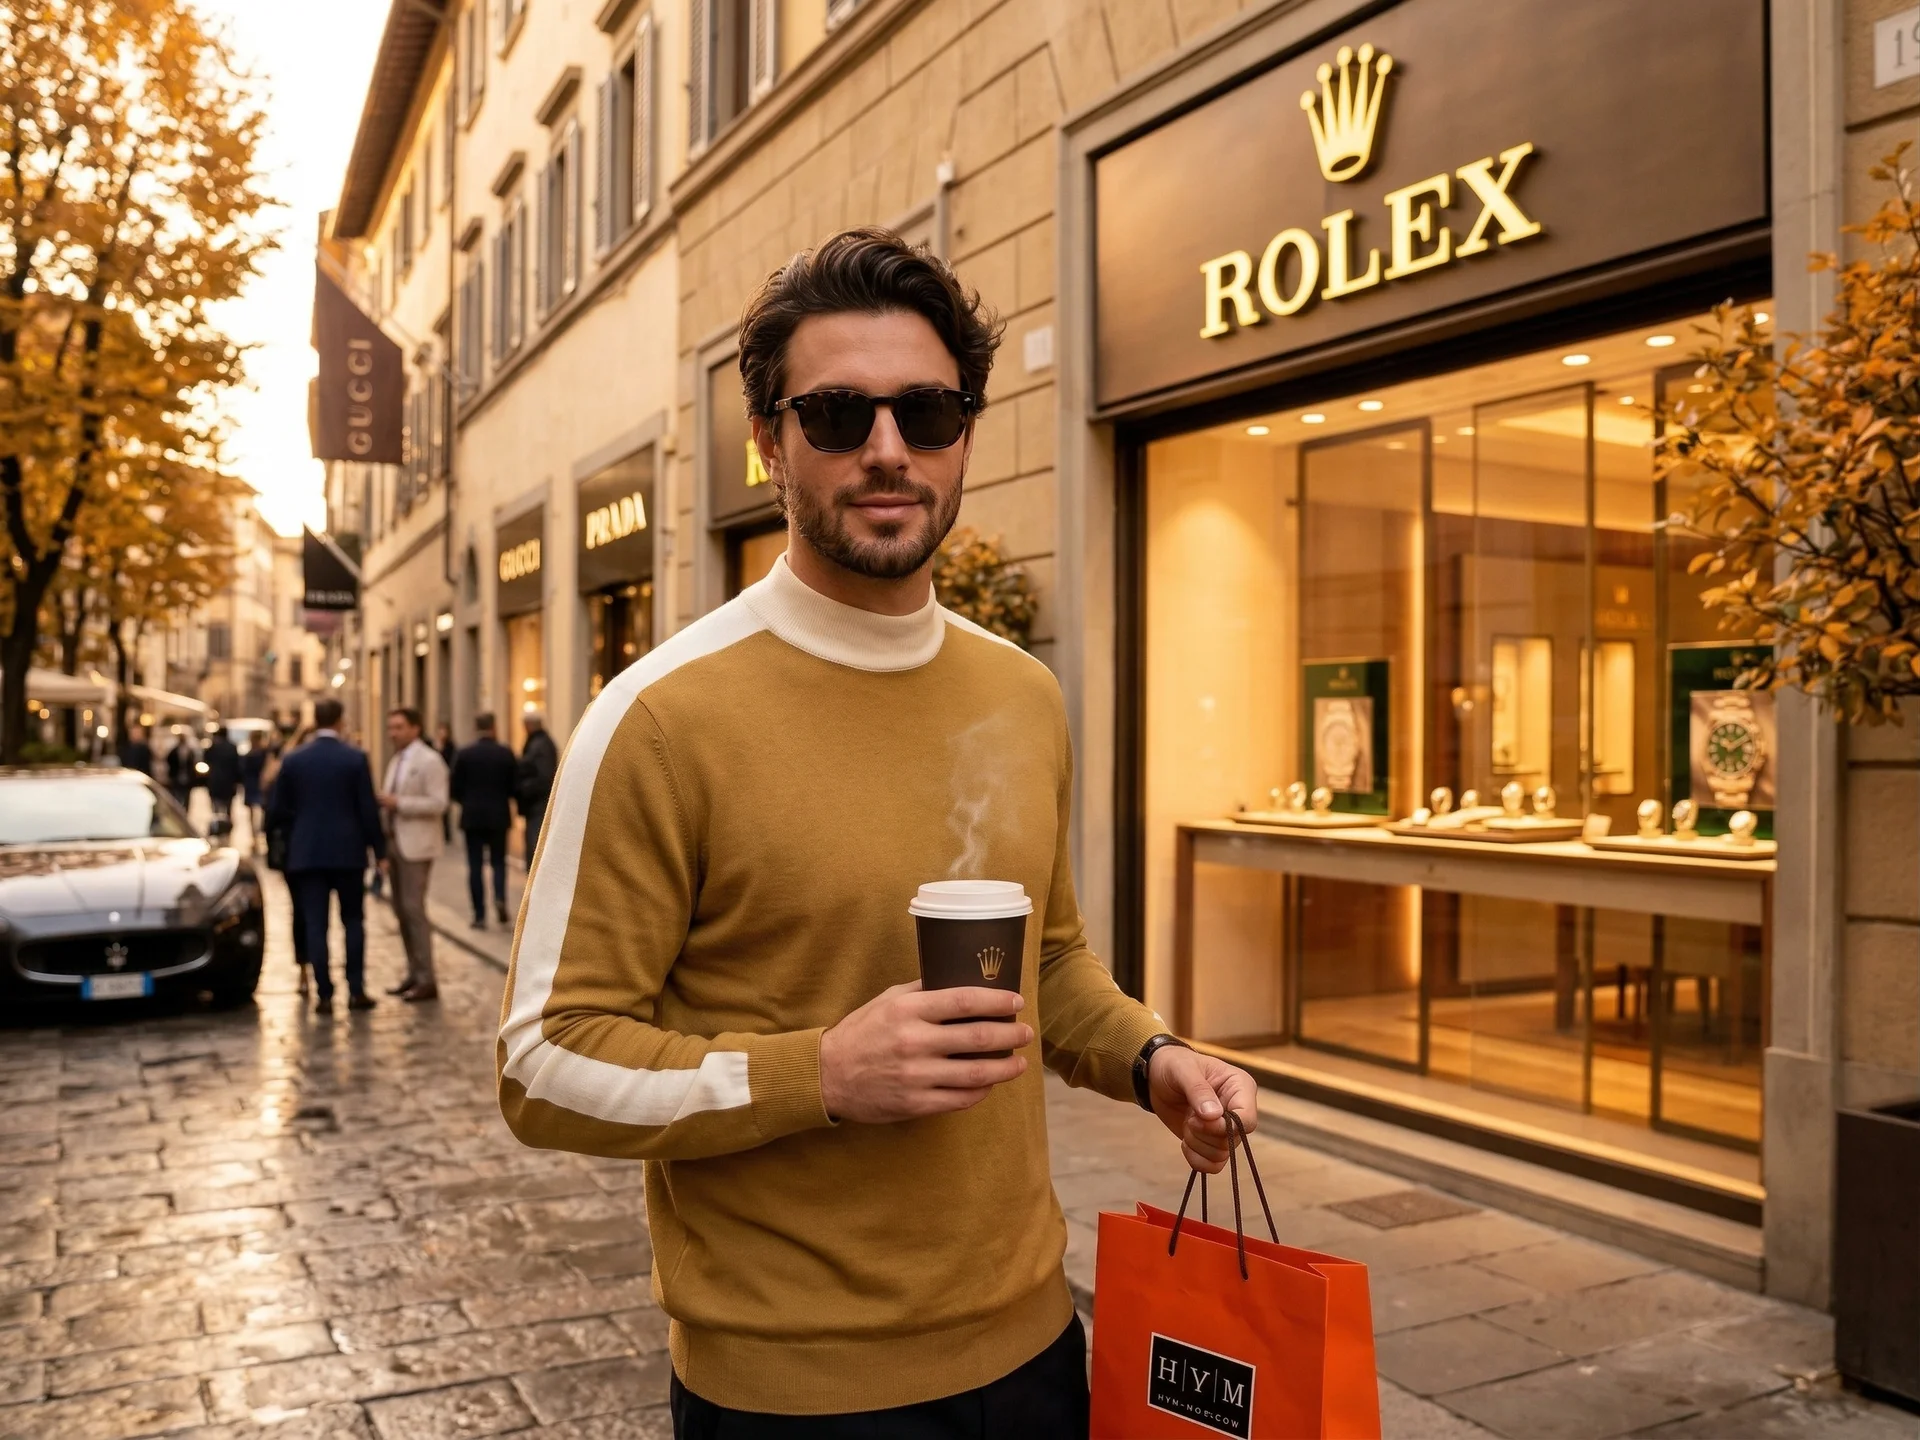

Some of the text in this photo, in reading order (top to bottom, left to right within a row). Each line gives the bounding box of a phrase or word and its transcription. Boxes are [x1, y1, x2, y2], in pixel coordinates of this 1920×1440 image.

[1199, 141, 1542, 339] ROLEX
[346, 339, 373, 455] GUCCI
[585, 491, 647, 550] PRADA
